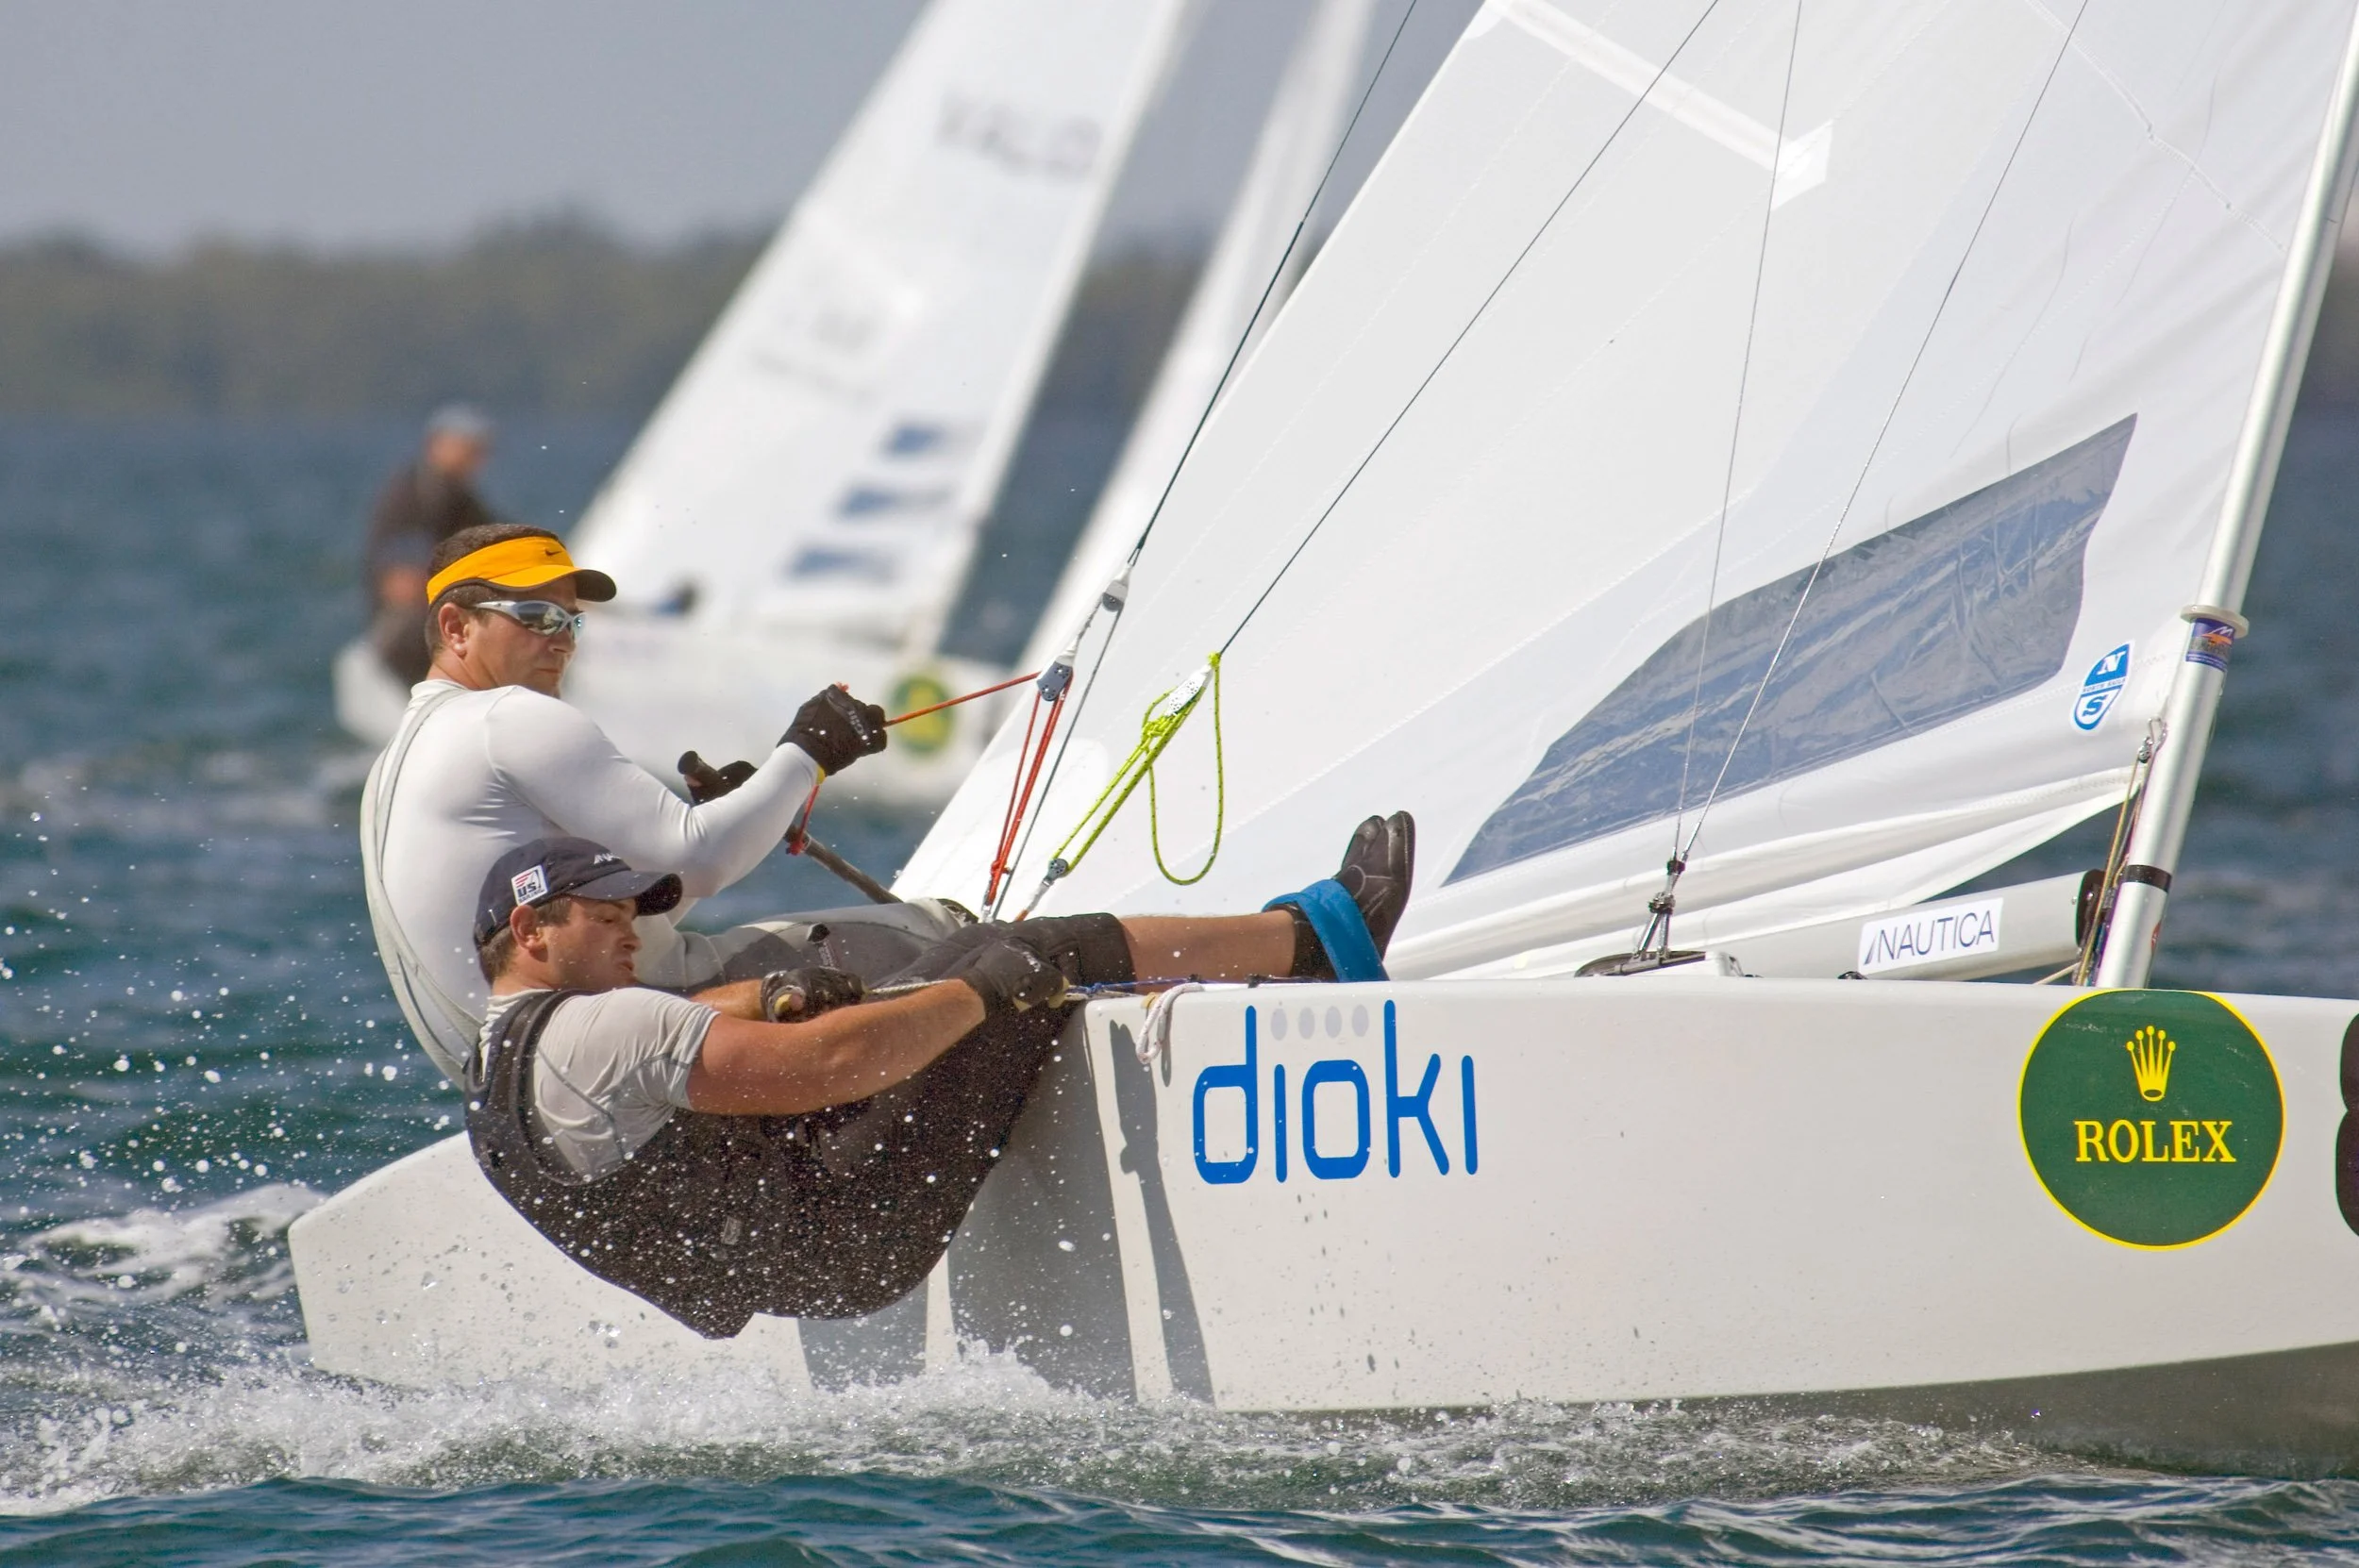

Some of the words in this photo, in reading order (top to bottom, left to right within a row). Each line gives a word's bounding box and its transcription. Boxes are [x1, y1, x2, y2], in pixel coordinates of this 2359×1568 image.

[2097, 650, 2127, 675] N
[2082, 694, 2109, 717] S
[1877, 909, 1995, 962] NAUTICA
[2073, 1119, 2236, 1163] ROLEX
